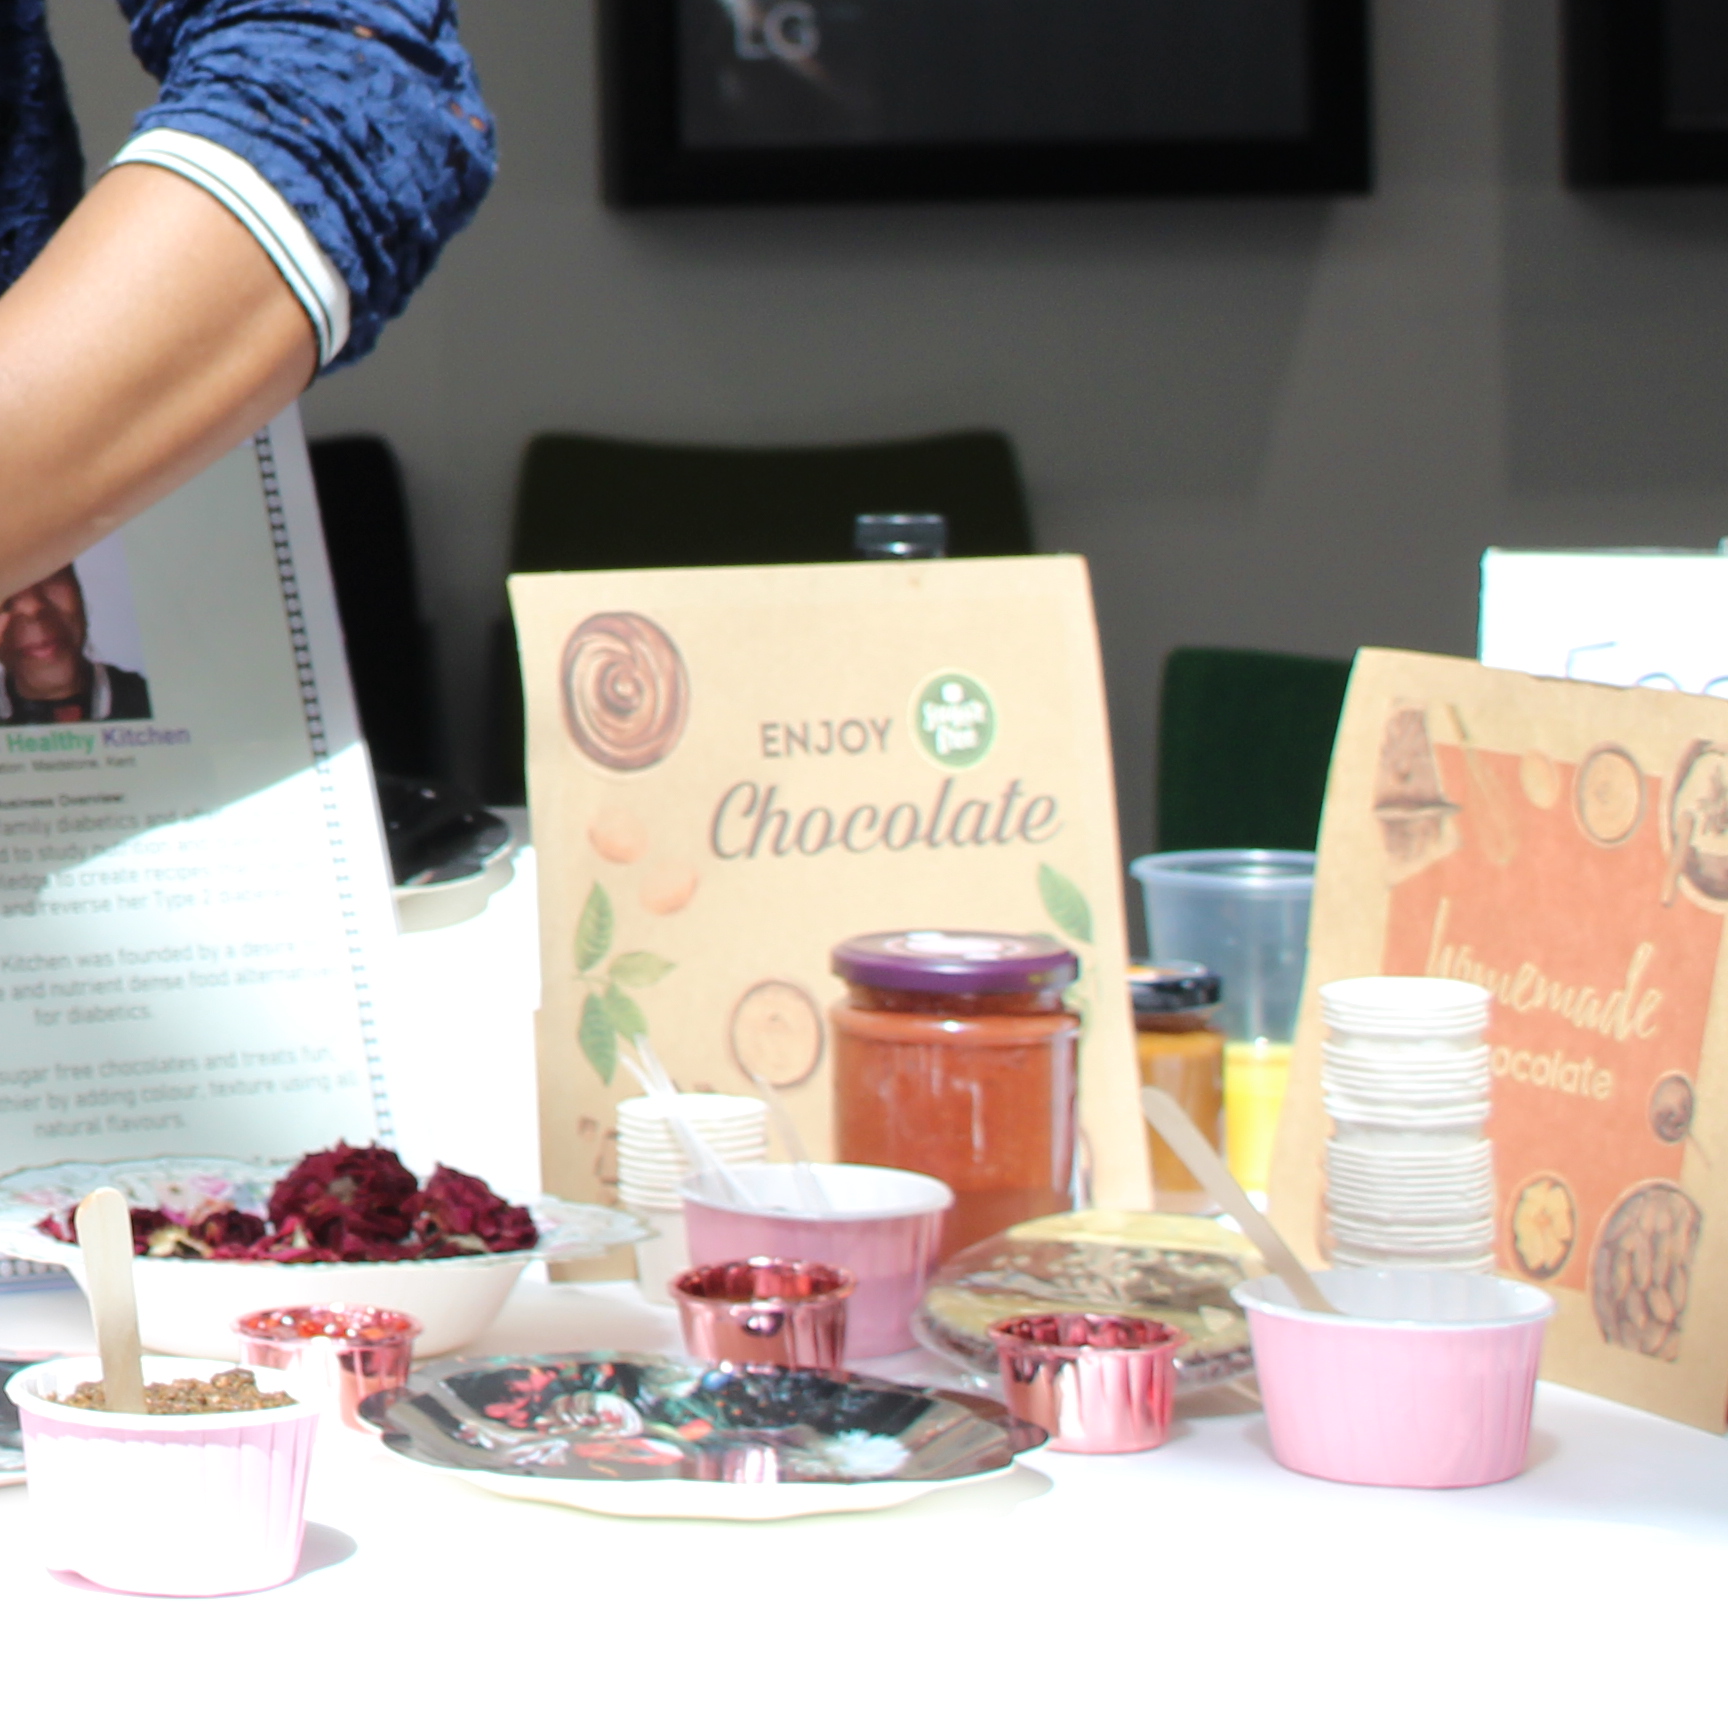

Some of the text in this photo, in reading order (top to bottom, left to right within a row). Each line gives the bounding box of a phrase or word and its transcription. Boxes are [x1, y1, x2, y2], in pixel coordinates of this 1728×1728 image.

[6, 730, 95, 755] Healthy
[101, 725, 192, 748] Kitchen
[761, 717, 894, 758] ENJOY
[709, 776, 1064, 861] Chocolate
[13, 844, 34, 864] to
[1, 899, 38, 920] and
[118, 892, 150, 914] her
[153, 888, 197, 915] Type
[0, 952, 72, 976] Kitchen
[74, 950, 115, 970] was
[117, 942, 195, 968] founded
[197, 942, 221, 966] by
[9, 980, 47, 1003] and
[50, 973, 127, 1000] nutrient
[128, 970, 186, 994] dense
[187, 965, 231, 990] food
[33, 1007, 63, 1028] for
[54, 1058, 96, 1082] free
[97, 1052, 202, 1080] chocolates
[203, 1049, 238, 1072] and
[240, 1046, 300, 1070] treats
[1490, 1045, 1614, 1101] ocolate
[44, 1090, 71, 1116] by
[73, 1084, 138, 1112] adding
[208, 1076, 278, 1101] texture
[33, 1117, 105, 1141] natural
